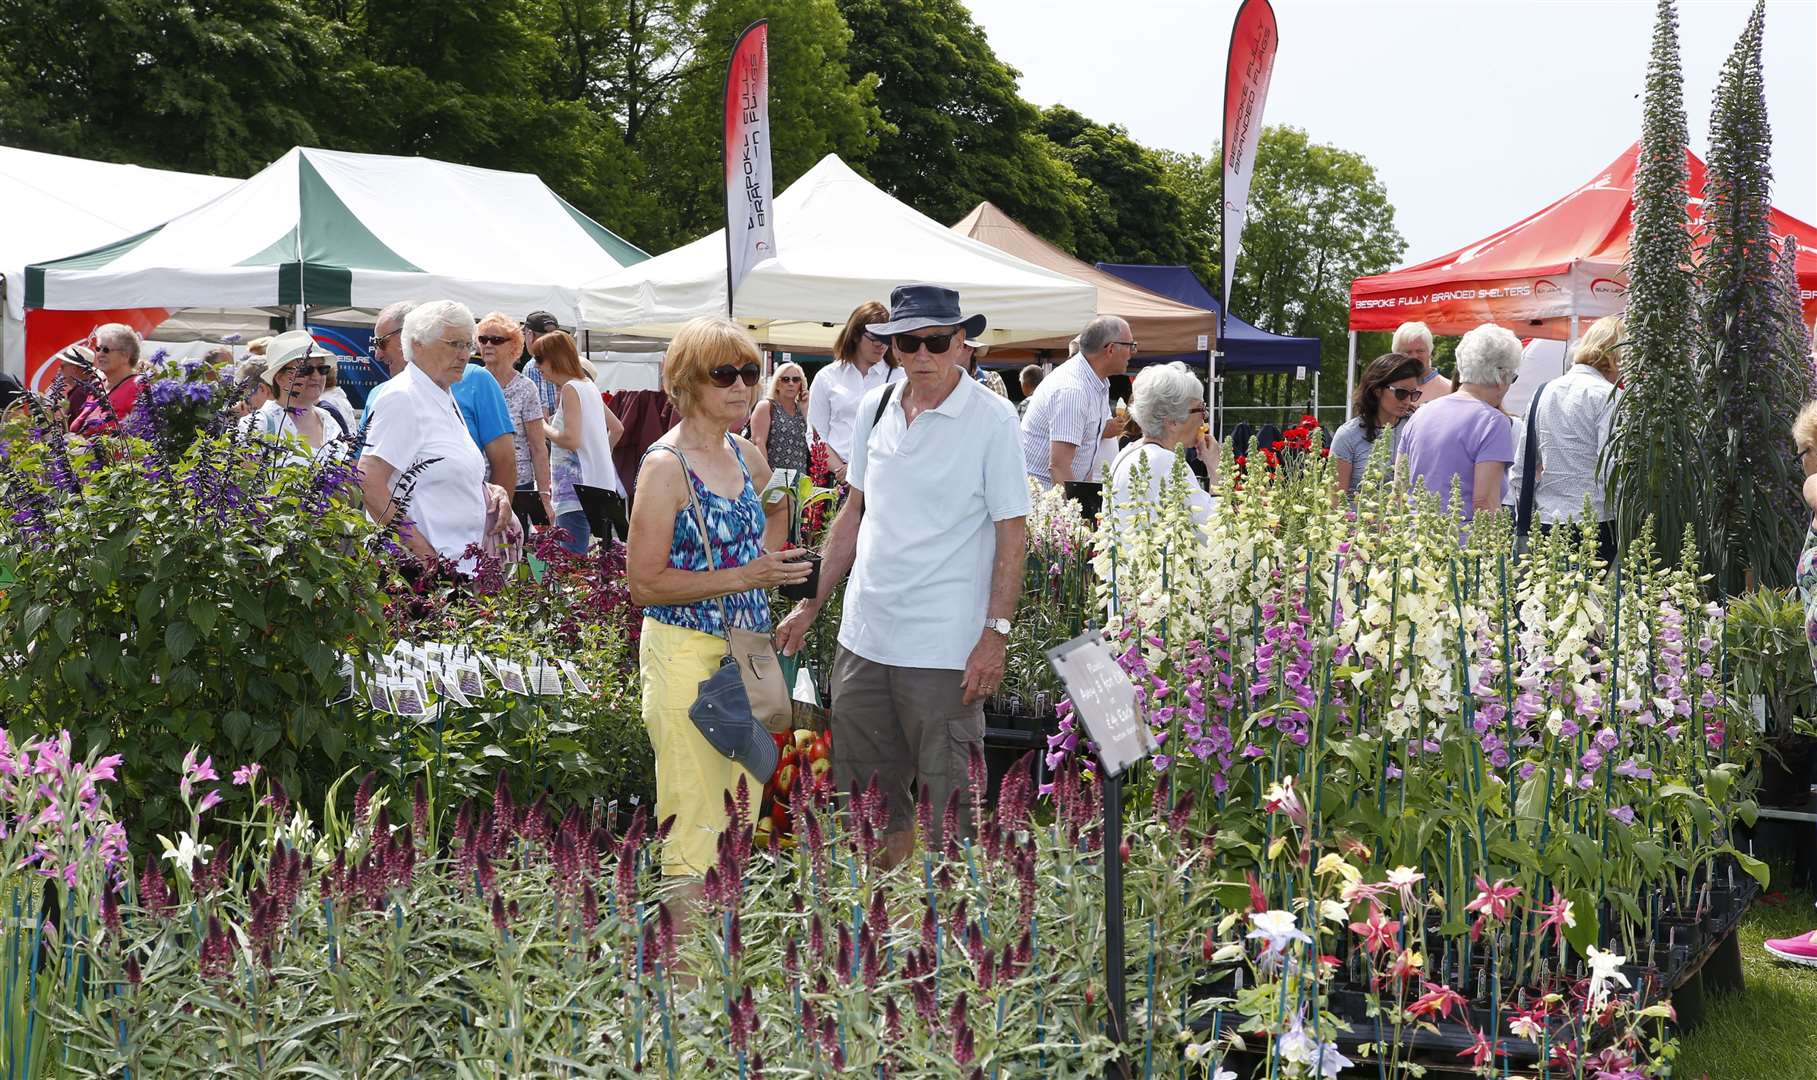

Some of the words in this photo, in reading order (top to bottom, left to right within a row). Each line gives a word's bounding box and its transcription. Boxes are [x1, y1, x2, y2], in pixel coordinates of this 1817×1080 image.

[1229, 82, 1249, 168] BESPOKE
[1246, 17, 1263, 79] FULLY
[1234, 90, 1255, 175] BRANDED
[1253, 27, 1270, 86] FLAGS
[1355, 298, 1396, 309] BESPOKE
[1398, 295, 1429, 306] FULLY
[1431, 290, 1476, 302] BRANDED
[1478, 286, 1530, 298] SHELTERS
[336, 355, 370, 363] EISURE
